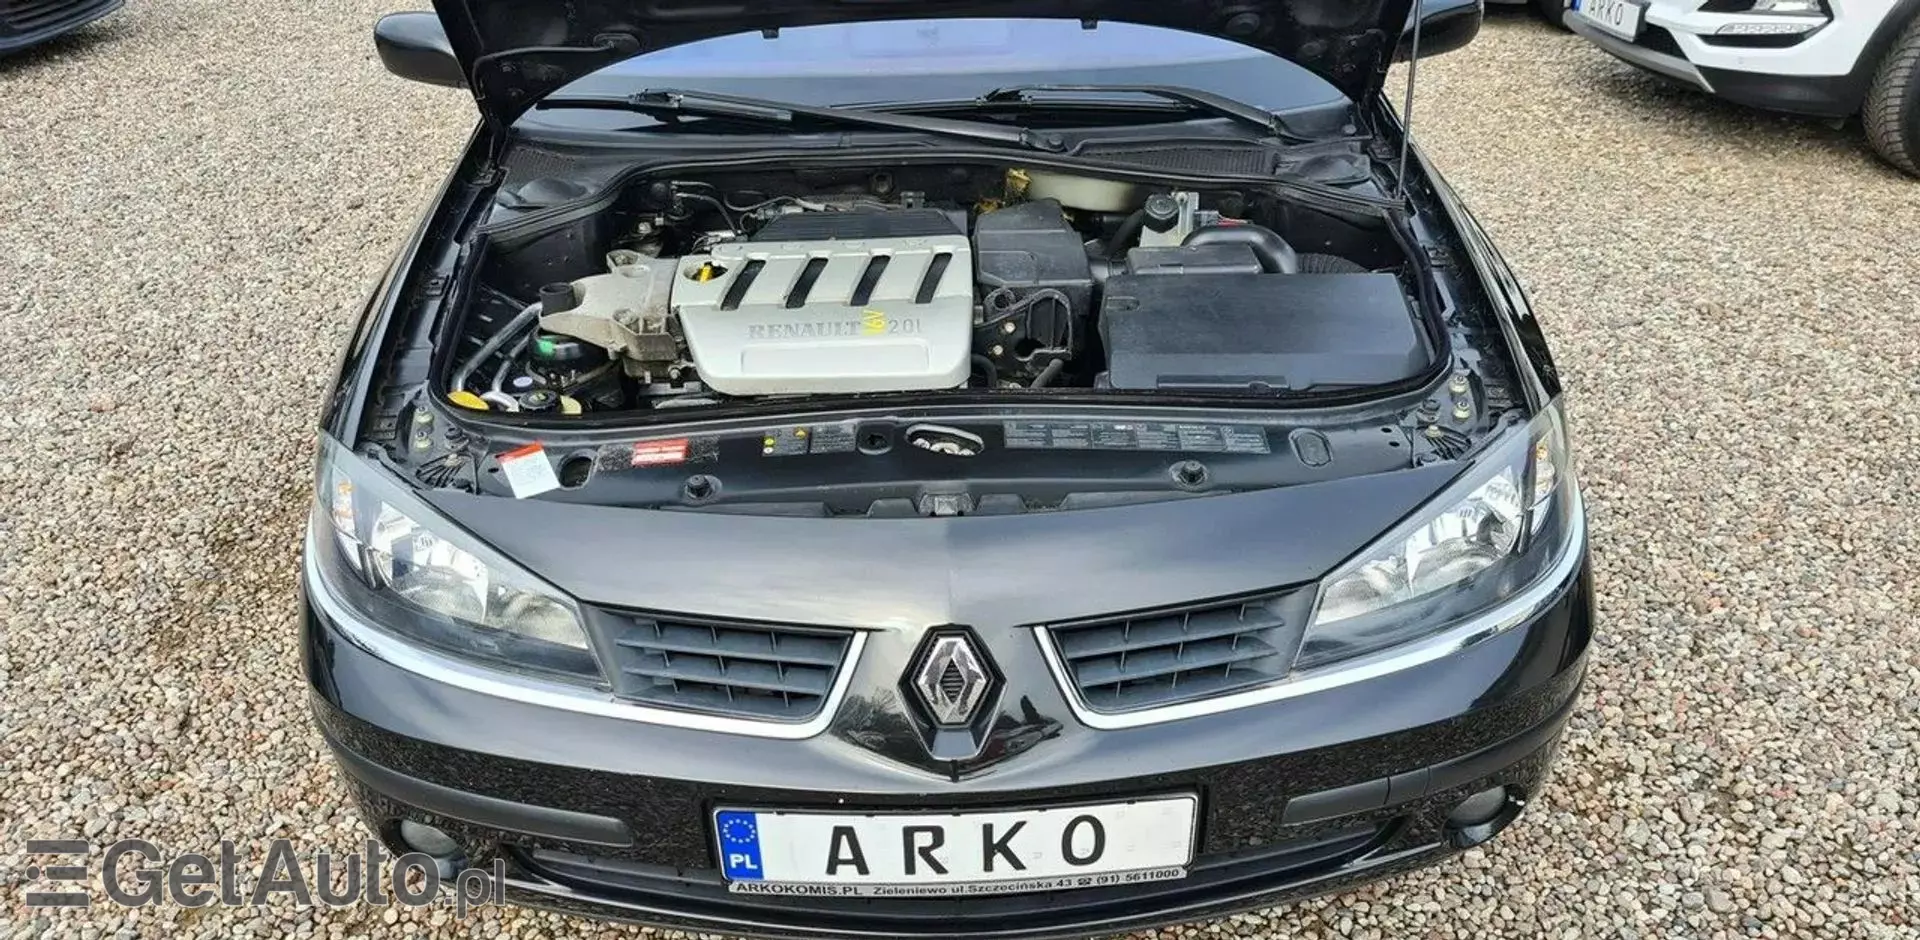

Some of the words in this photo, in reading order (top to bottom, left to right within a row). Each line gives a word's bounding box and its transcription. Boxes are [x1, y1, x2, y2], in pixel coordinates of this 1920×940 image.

[748, 321, 861, 339] RENAULT
[825, 814, 1106, 875] ARKO
[729, 853, 758, 870] PL
[736, 883, 863, 896] ARKOKOMIS.PL
[873, 886, 947, 895] Zieleniewo
[1056, 878, 1073, 888] 43
[1096, 874, 1120, 885] (91)
[1125, 868, 1180, 882] 5611000
